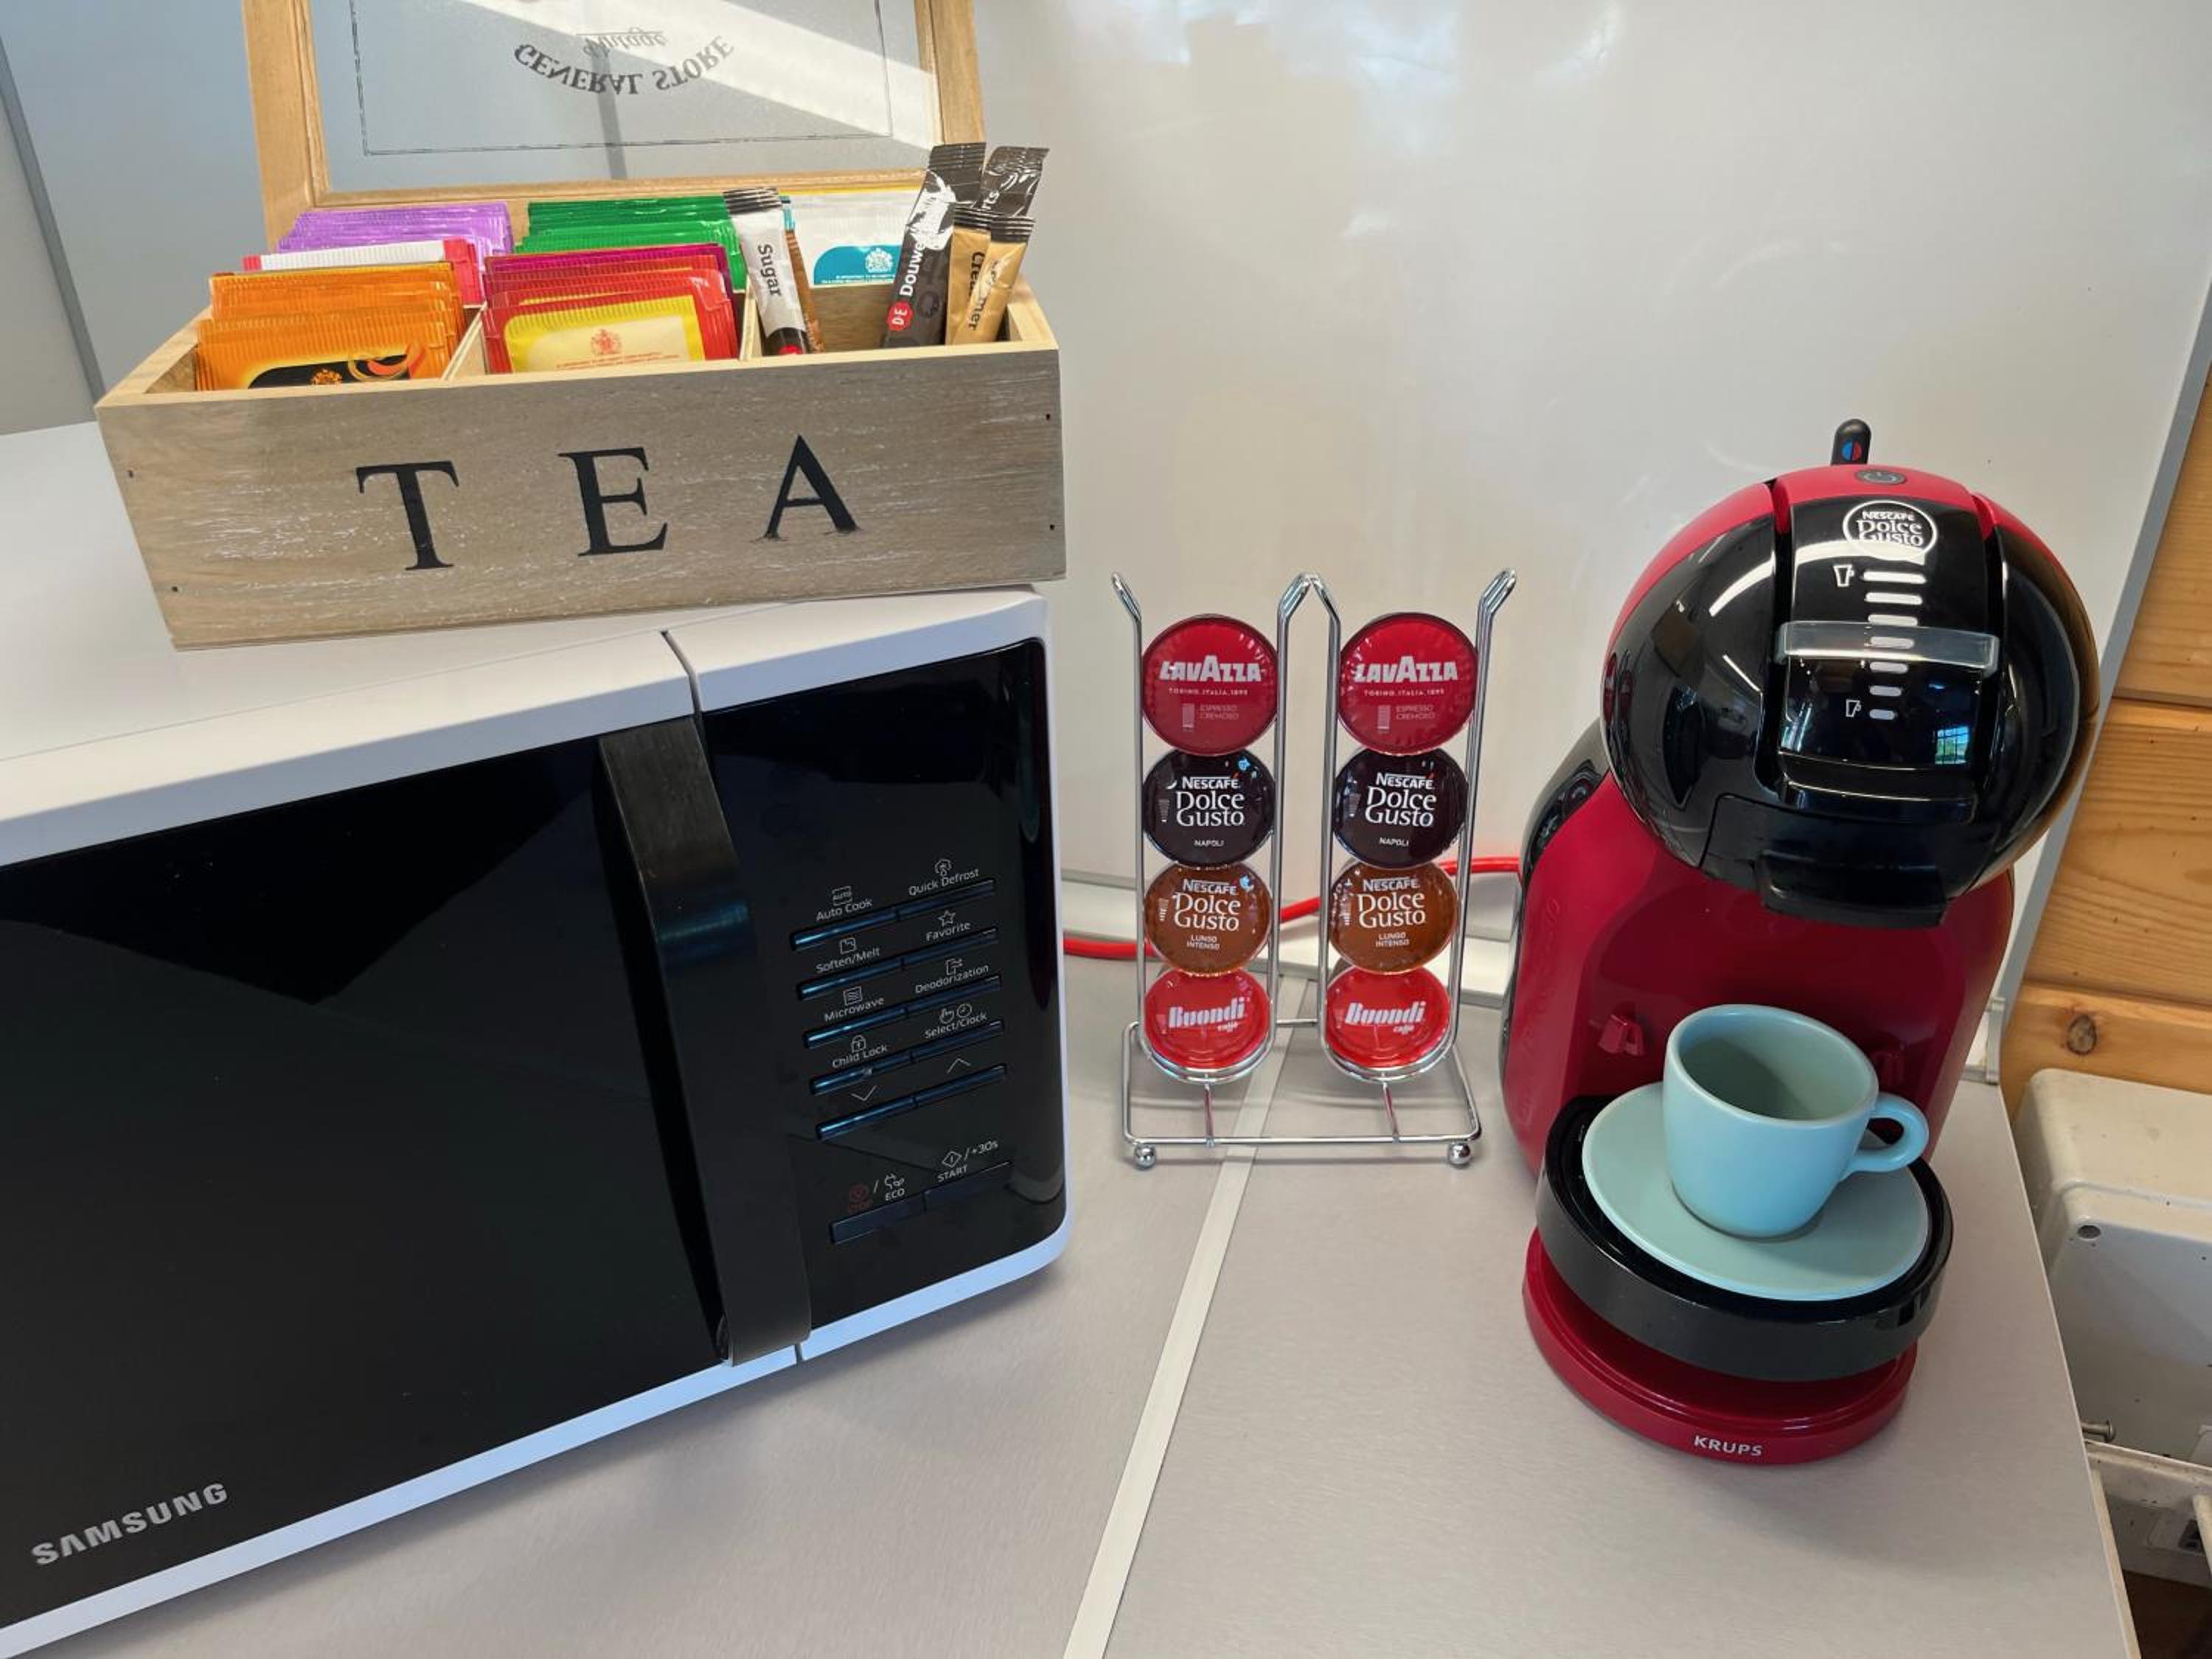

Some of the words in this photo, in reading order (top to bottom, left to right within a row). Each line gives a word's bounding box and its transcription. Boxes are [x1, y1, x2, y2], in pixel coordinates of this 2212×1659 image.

[757, 244, 781, 296] Sugar
[1856, 519, 1922, 535] Dolce
[1859, 532, 1924, 546] Gusto
[1159, 654, 1262, 682] LAVAZZA
[1354, 655, 1458, 683] LAVAZZA
[1176, 790, 1245, 810] Dolce
[1367, 785, 1436, 810] Dolce
[1176, 808, 1245, 827] Gusto
[1365, 806, 1434, 827] Gusto
[1194, 839, 1225, 847] NAPOLI
[1379, 837, 1409, 846] NAPOLI
[908, 879, 939, 896] Quick
[942, 869, 979, 886] Defrost
[816, 907, 842, 921] Auto
[846, 898, 873, 913] Cook
[1173, 891, 1241, 915] Dolce
[1357, 891, 1425, 914] Dolce
[1174, 911, 1239, 931] Gusto
[1359, 908, 1426, 929] Gusto
[926, 922, 970, 941] Favorite
[1191, 934, 1217, 943] LUNGO
[1378, 931, 1406, 940] LUNGO
[1186, 941, 1220, 950] INTENSO
[1375, 939, 1410, 947] INTENSO
[816, 947, 880, 973] Soften/Melt
[915, 964, 989, 993] Deodorization
[824, 998, 884, 1022] Microwave
[1169, 997, 1245, 1028] Buondi
[924, 1012, 987, 1039] Select/Clock
[832, 1051, 859, 1068] Child
[863, 1044, 888, 1058] Lock
[937, 1164, 968, 1182] START
[885, 1188, 905, 1201] ECO
[1694, 1435, 1763, 1456] KRUPS
[31, 1483, 229, 1566] SAMSUNG
